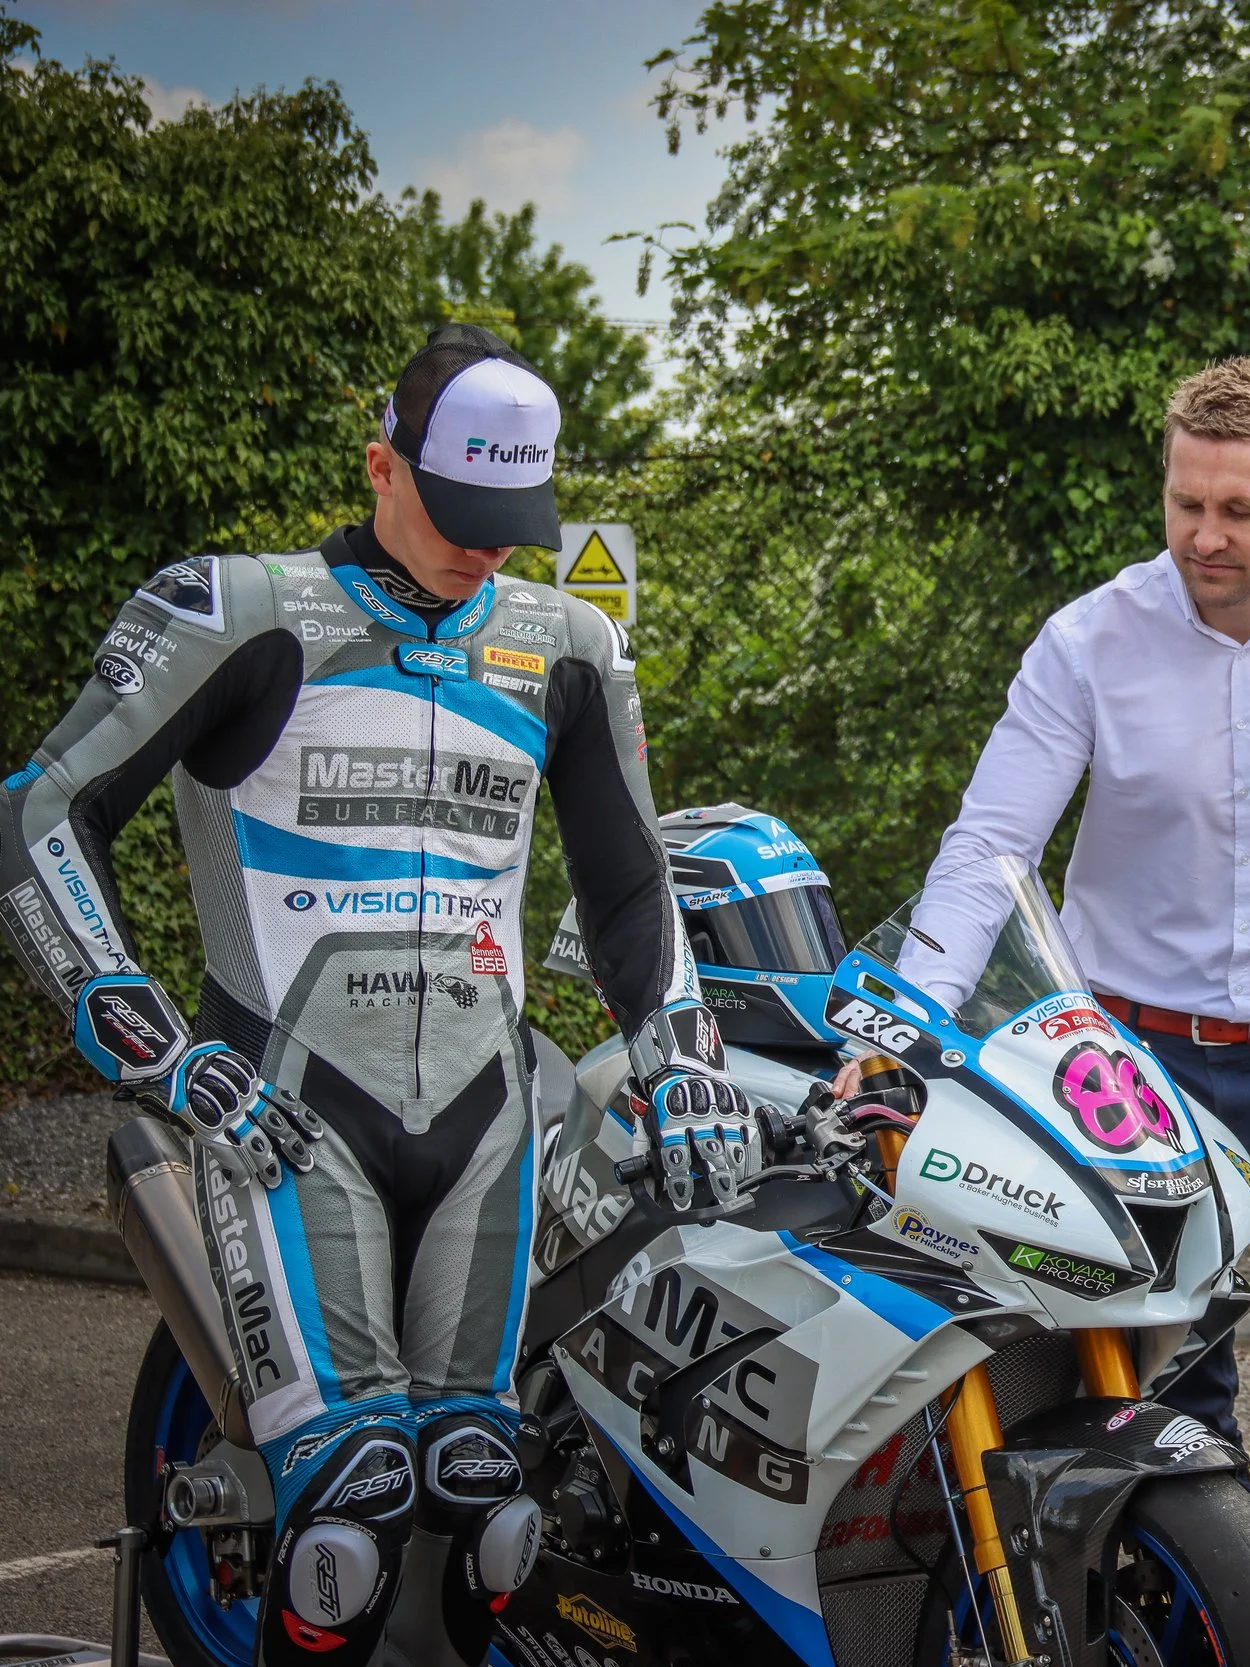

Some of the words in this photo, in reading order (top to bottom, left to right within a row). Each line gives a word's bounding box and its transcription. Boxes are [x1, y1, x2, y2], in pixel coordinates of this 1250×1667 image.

[283, 600, 347, 614] SHARK
[352, 581, 407, 622] RST
[458, 592, 486, 633] RST
[116, 620, 143, 634] BUILT
[144, 629, 177, 653] WITH
[326, 625, 370, 637] Druck
[104, 630, 169, 669] Kevlar
[404, 649, 467, 668] RST
[490, 649, 540, 671] PIRELLI
[100, 659, 136, 685] R&G
[305, 802, 516, 835] SURFACING
[325, 890, 502, 920] VISIONTRACK
[688, 890, 729, 907] SHARK
[471, 946, 504, 958] Bennetts
[471, 957, 507, 973] BSB
[704, 998, 747, 1010] OJECTS
[99, 996, 169, 1044] RST
[831, 998, 920, 1053] R&G
[962, 1162, 1066, 1220] Druck
[1148, 1176, 1190, 1189] SPRINT
[1167, 1178, 1205, 1196] FILTER
[966, 1184, 990, 1198] Baker
[991, 1192, 1023, 1211] Hughes
[1024, 1204, 1059, 1228] business
[900, 1216, 980, 1255] Paynes
[909, 1234, 921, 1243] of
[920, 1237, 961, 1260] Hinckley
[203, 1148, 281, 1389] asterMac
[1037, 1264, 1114, 1295] PROJECTS
[1043, 1253, 1116, 1284] KOVARA
[442, 1459, 517, 1479] RST
[333, 1466, 408, 1507] RST
[313, 1515, 377, 1540] SPECIFICATION
[316, 1543, 342, 1622] RST
[631, 1571, 739, 1605] HONDA
[560, 1597, 635, 1643] Putoline
